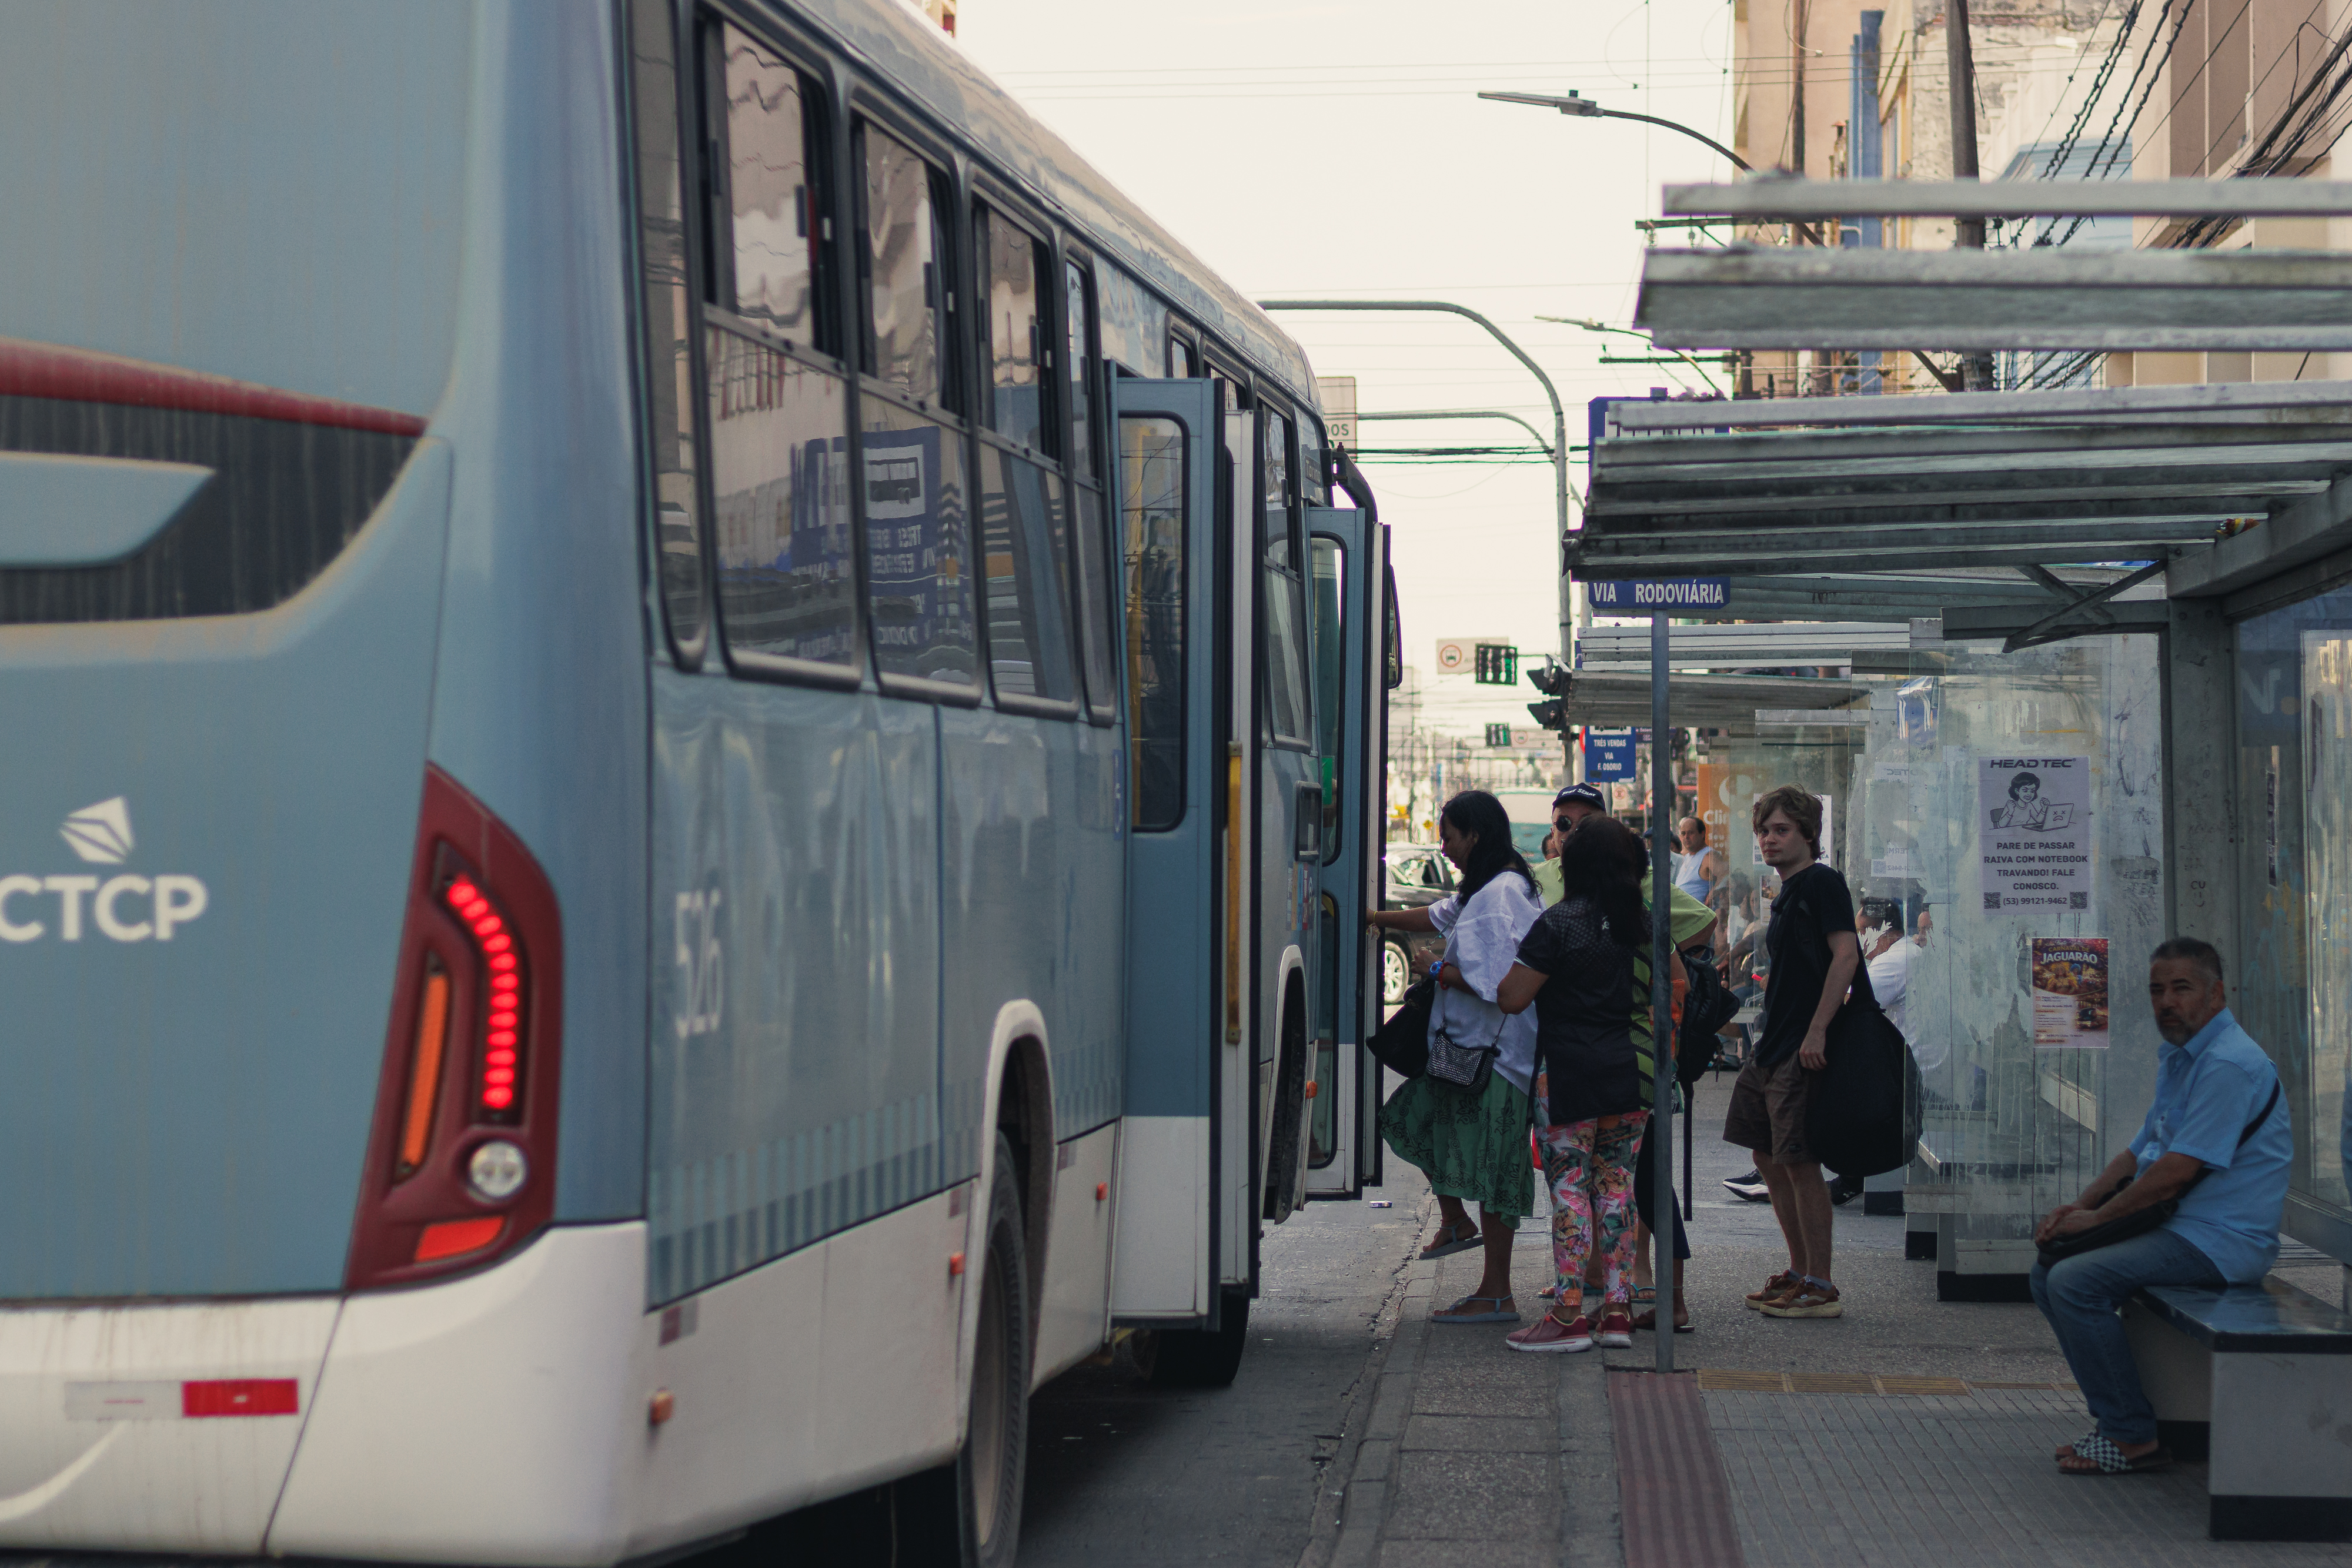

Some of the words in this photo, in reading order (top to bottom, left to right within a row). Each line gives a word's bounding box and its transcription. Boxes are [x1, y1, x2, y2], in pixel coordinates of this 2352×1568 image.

[1593, 583, 1616, 601] VIA
[1635, 580, 1724, 603] RODOVIÁRIA
[1593, 738, 1606, 747] TRÊS
[1990, 759, 2039, 768] HEAD
[1578, 788, 1596, 797] SENAT
[0, 874, 209, 942] CTCP
[2040, 952, 2098, 964] JAGUARÃO
